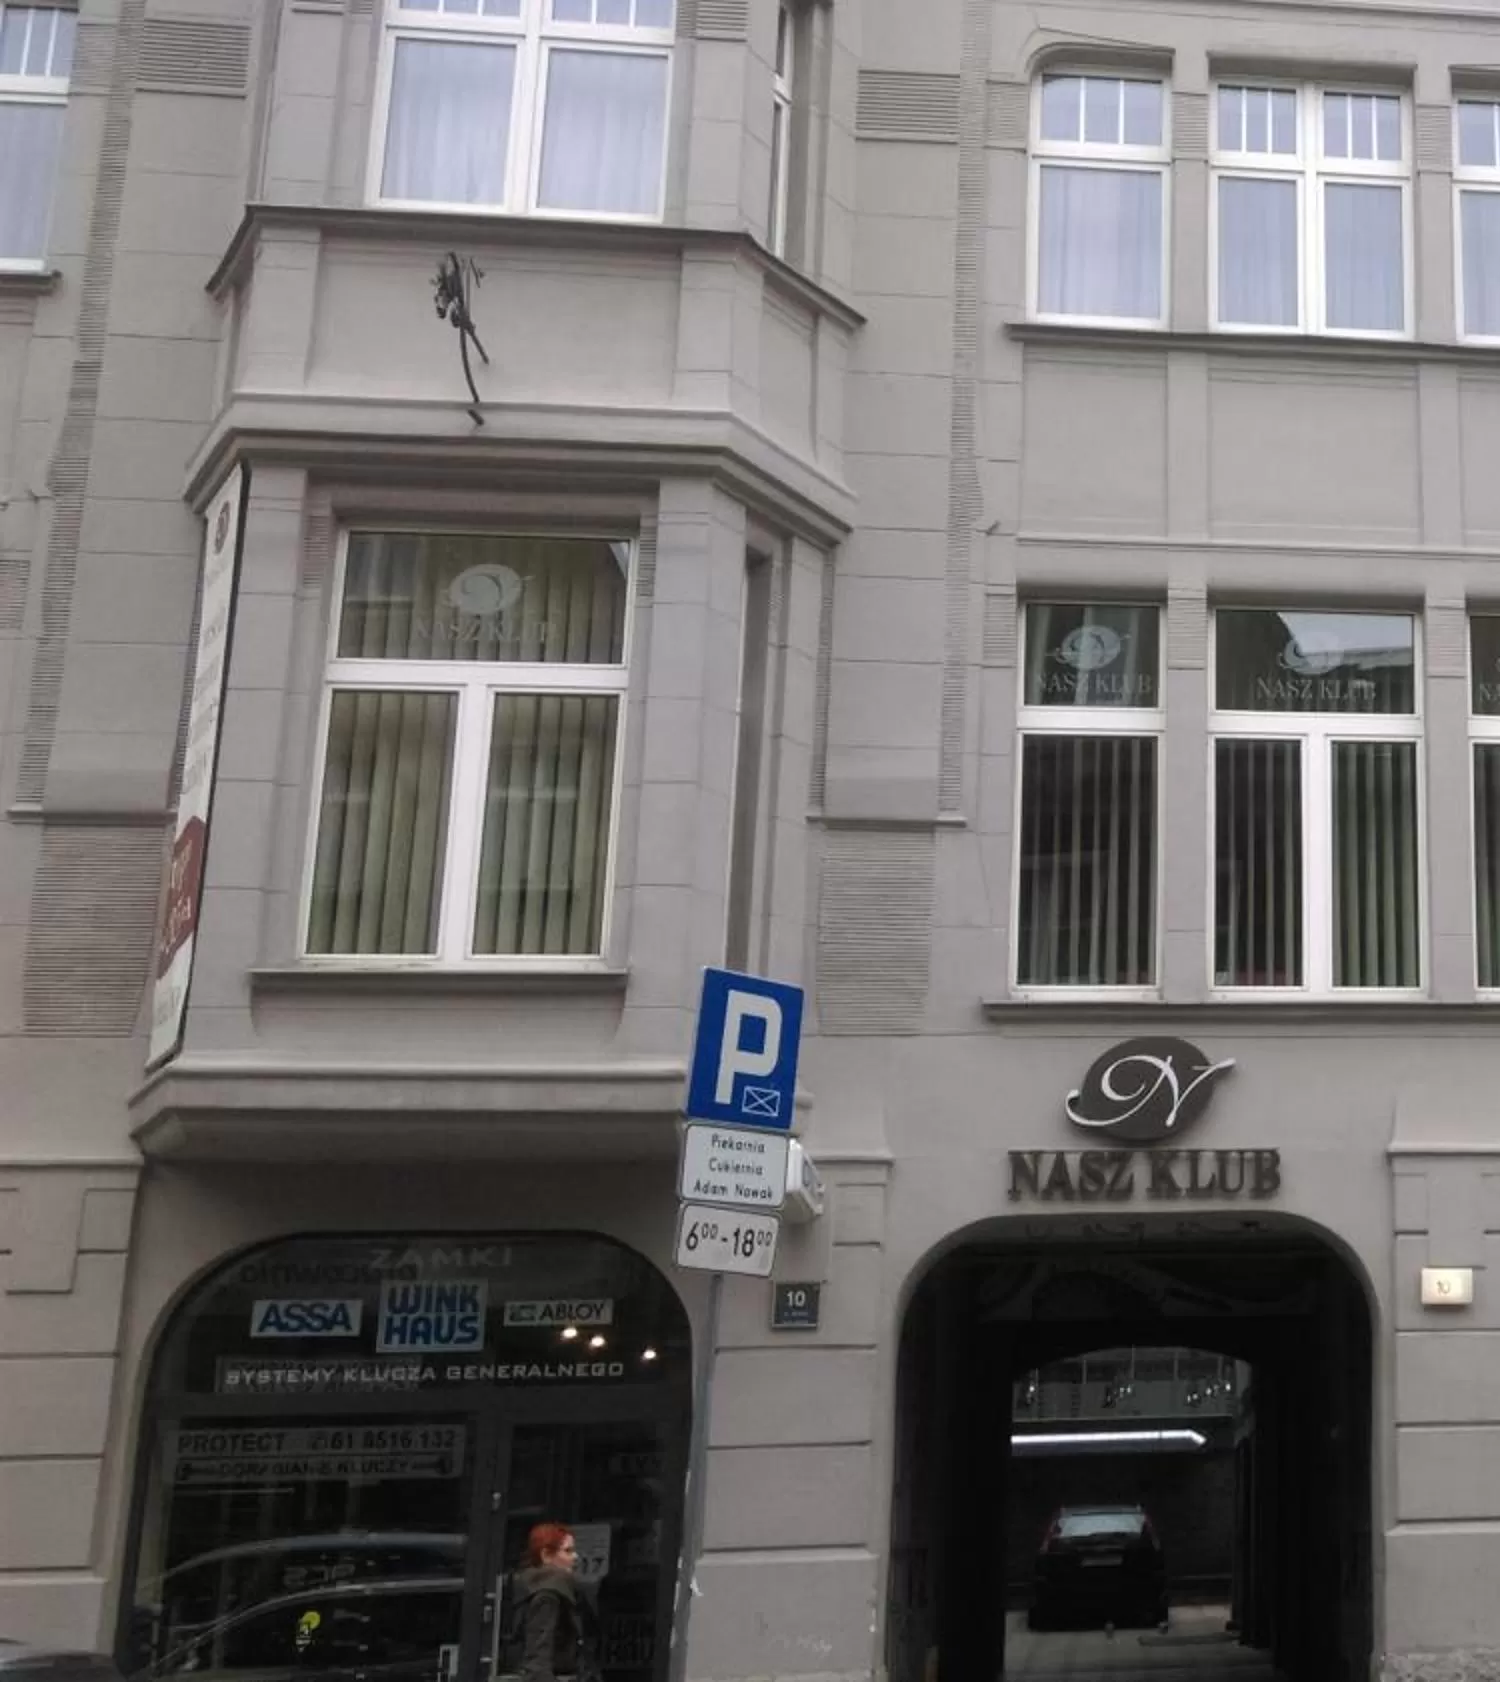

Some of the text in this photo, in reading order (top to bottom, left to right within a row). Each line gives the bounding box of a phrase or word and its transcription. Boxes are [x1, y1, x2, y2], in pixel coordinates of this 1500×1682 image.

[1256, 677, 1313, 699] NASZ
[714, 988, 784, 1105] P
[710, 1132, 766, 1154] Piekarnia
[708, 1157, 764, 1176] Cukiernia
[1007, 1148, 1281, 1202] NASZ KLUB
[693, 1179, 773, 1200] Adam Nowak
[368, 1245, 513, 1268] ZAMKI
[387, 1285, 481, 1315] WINK
[786, 1290, 806, 1308] 10
[257, 1302, 353, 1333] ASSA
[539, 1303, 605, 1321] ABLOY
[384, 1315, 479, 1345] HAUS
[225, 1362, 626, 1385] SYSTEMY KLUCZA GENERALNEGO
[178, 1433, 285, 1454] PROTECT
